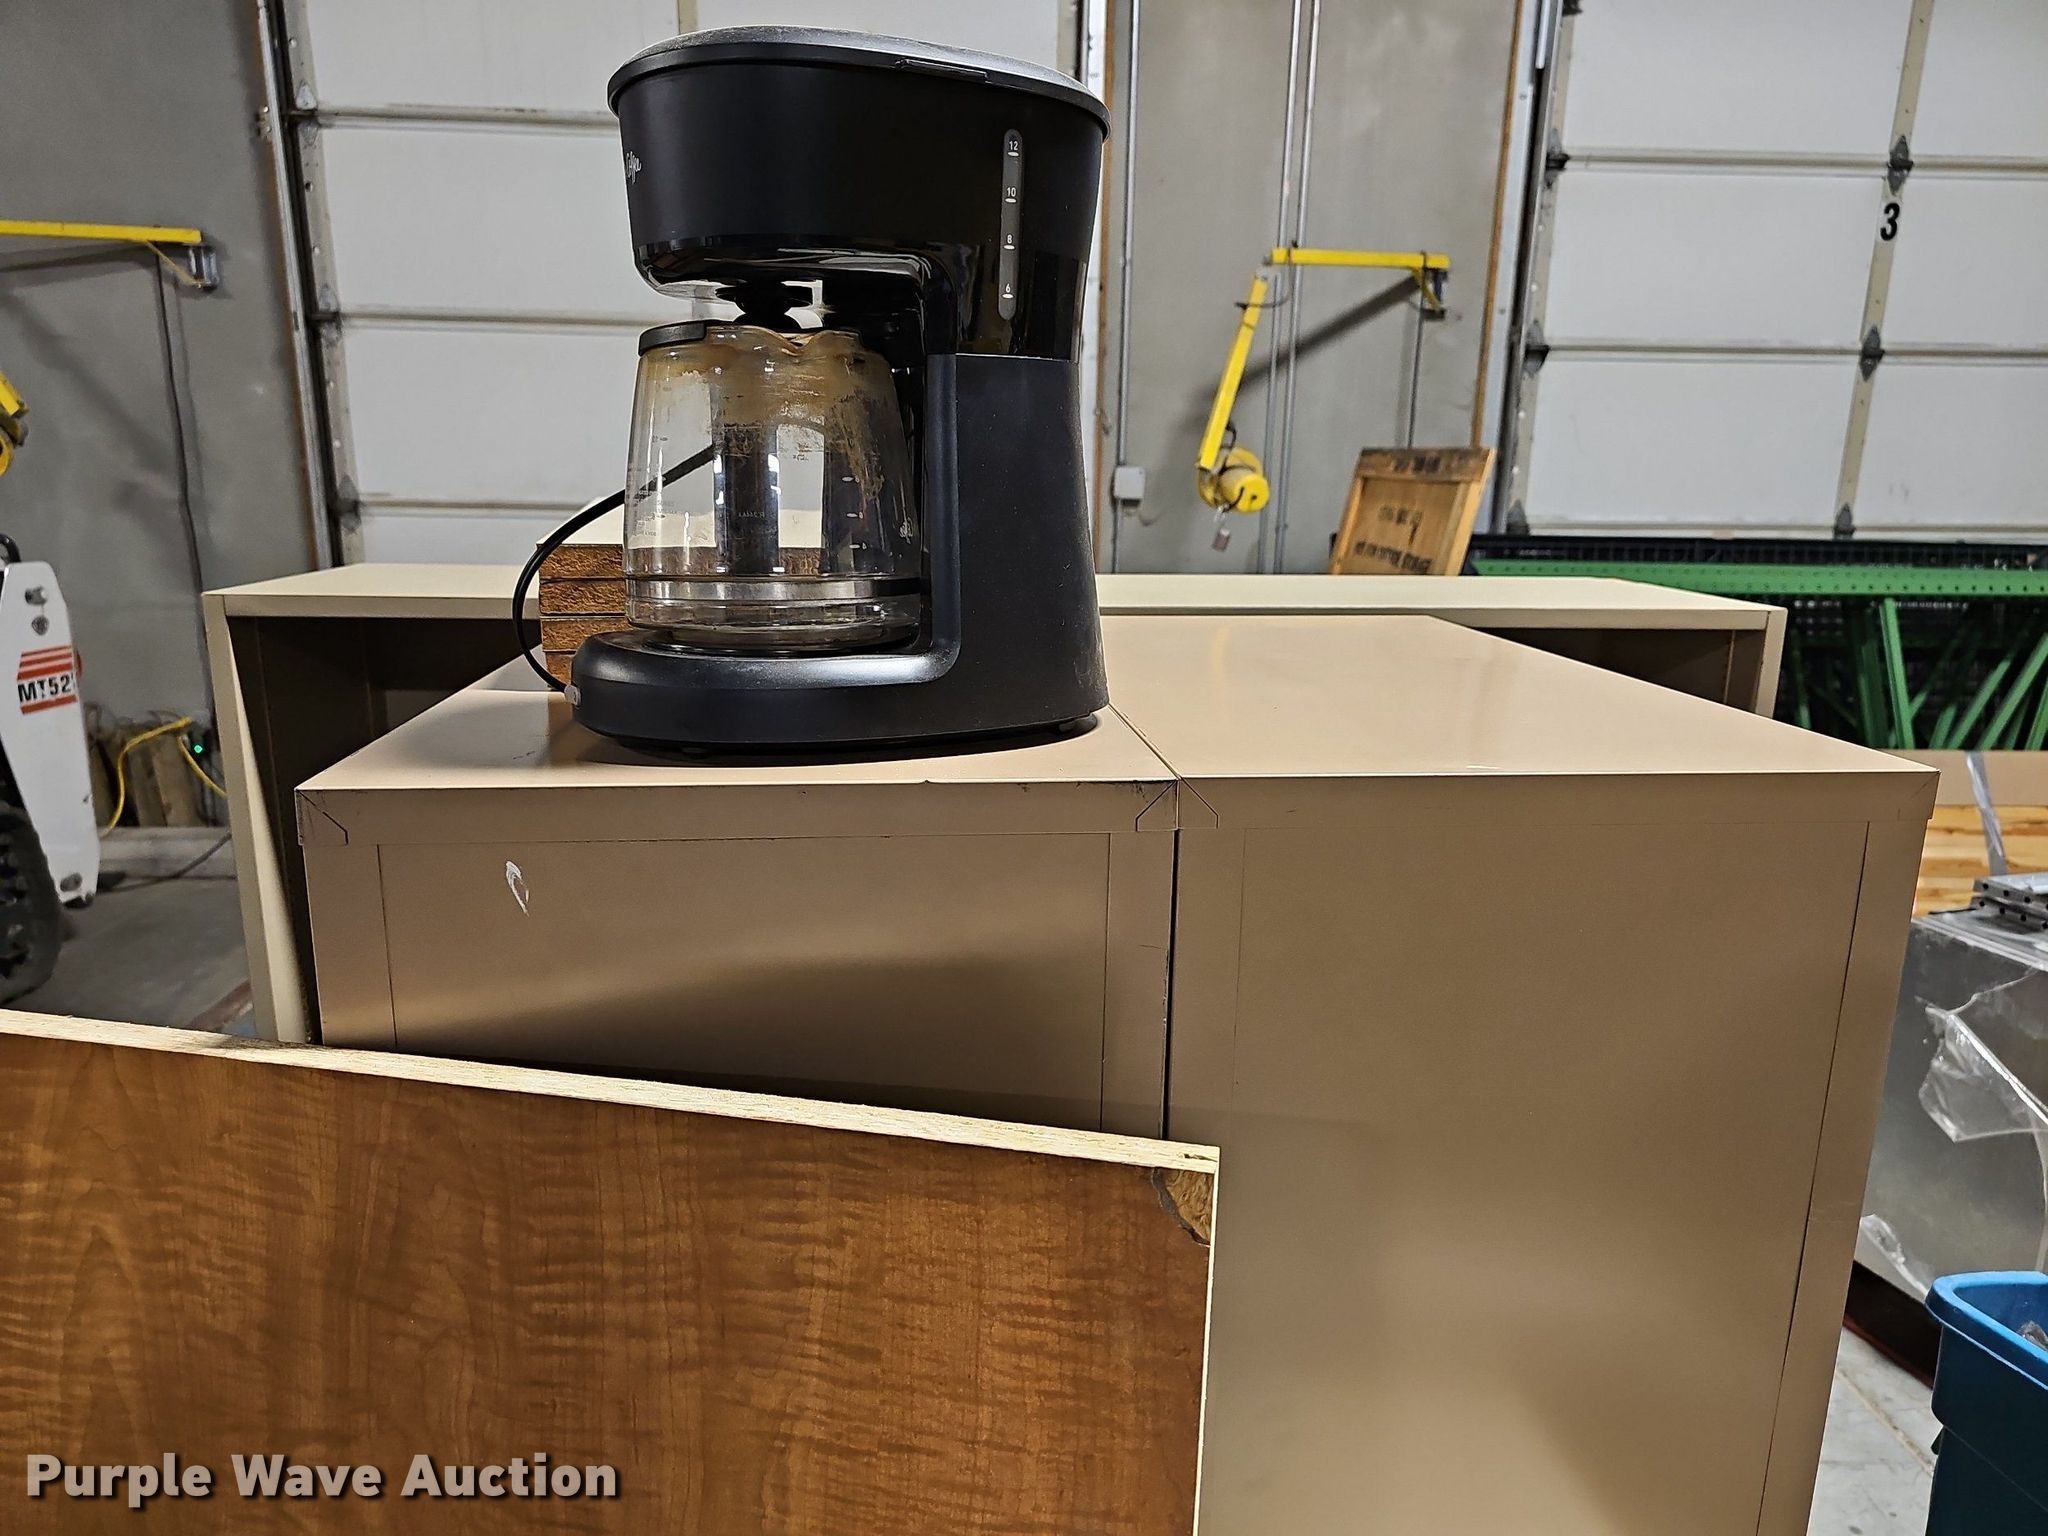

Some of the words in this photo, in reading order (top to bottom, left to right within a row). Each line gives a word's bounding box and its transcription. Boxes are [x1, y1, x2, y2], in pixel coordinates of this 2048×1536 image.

[1009, 140, 1019, 151] 12
[1006, 187, 1017, 197] 10
[1880, 202, 1900, 242] 3
[1006, 234, 1013, 244] 8
[1005, 283, 1011, 293] 6
